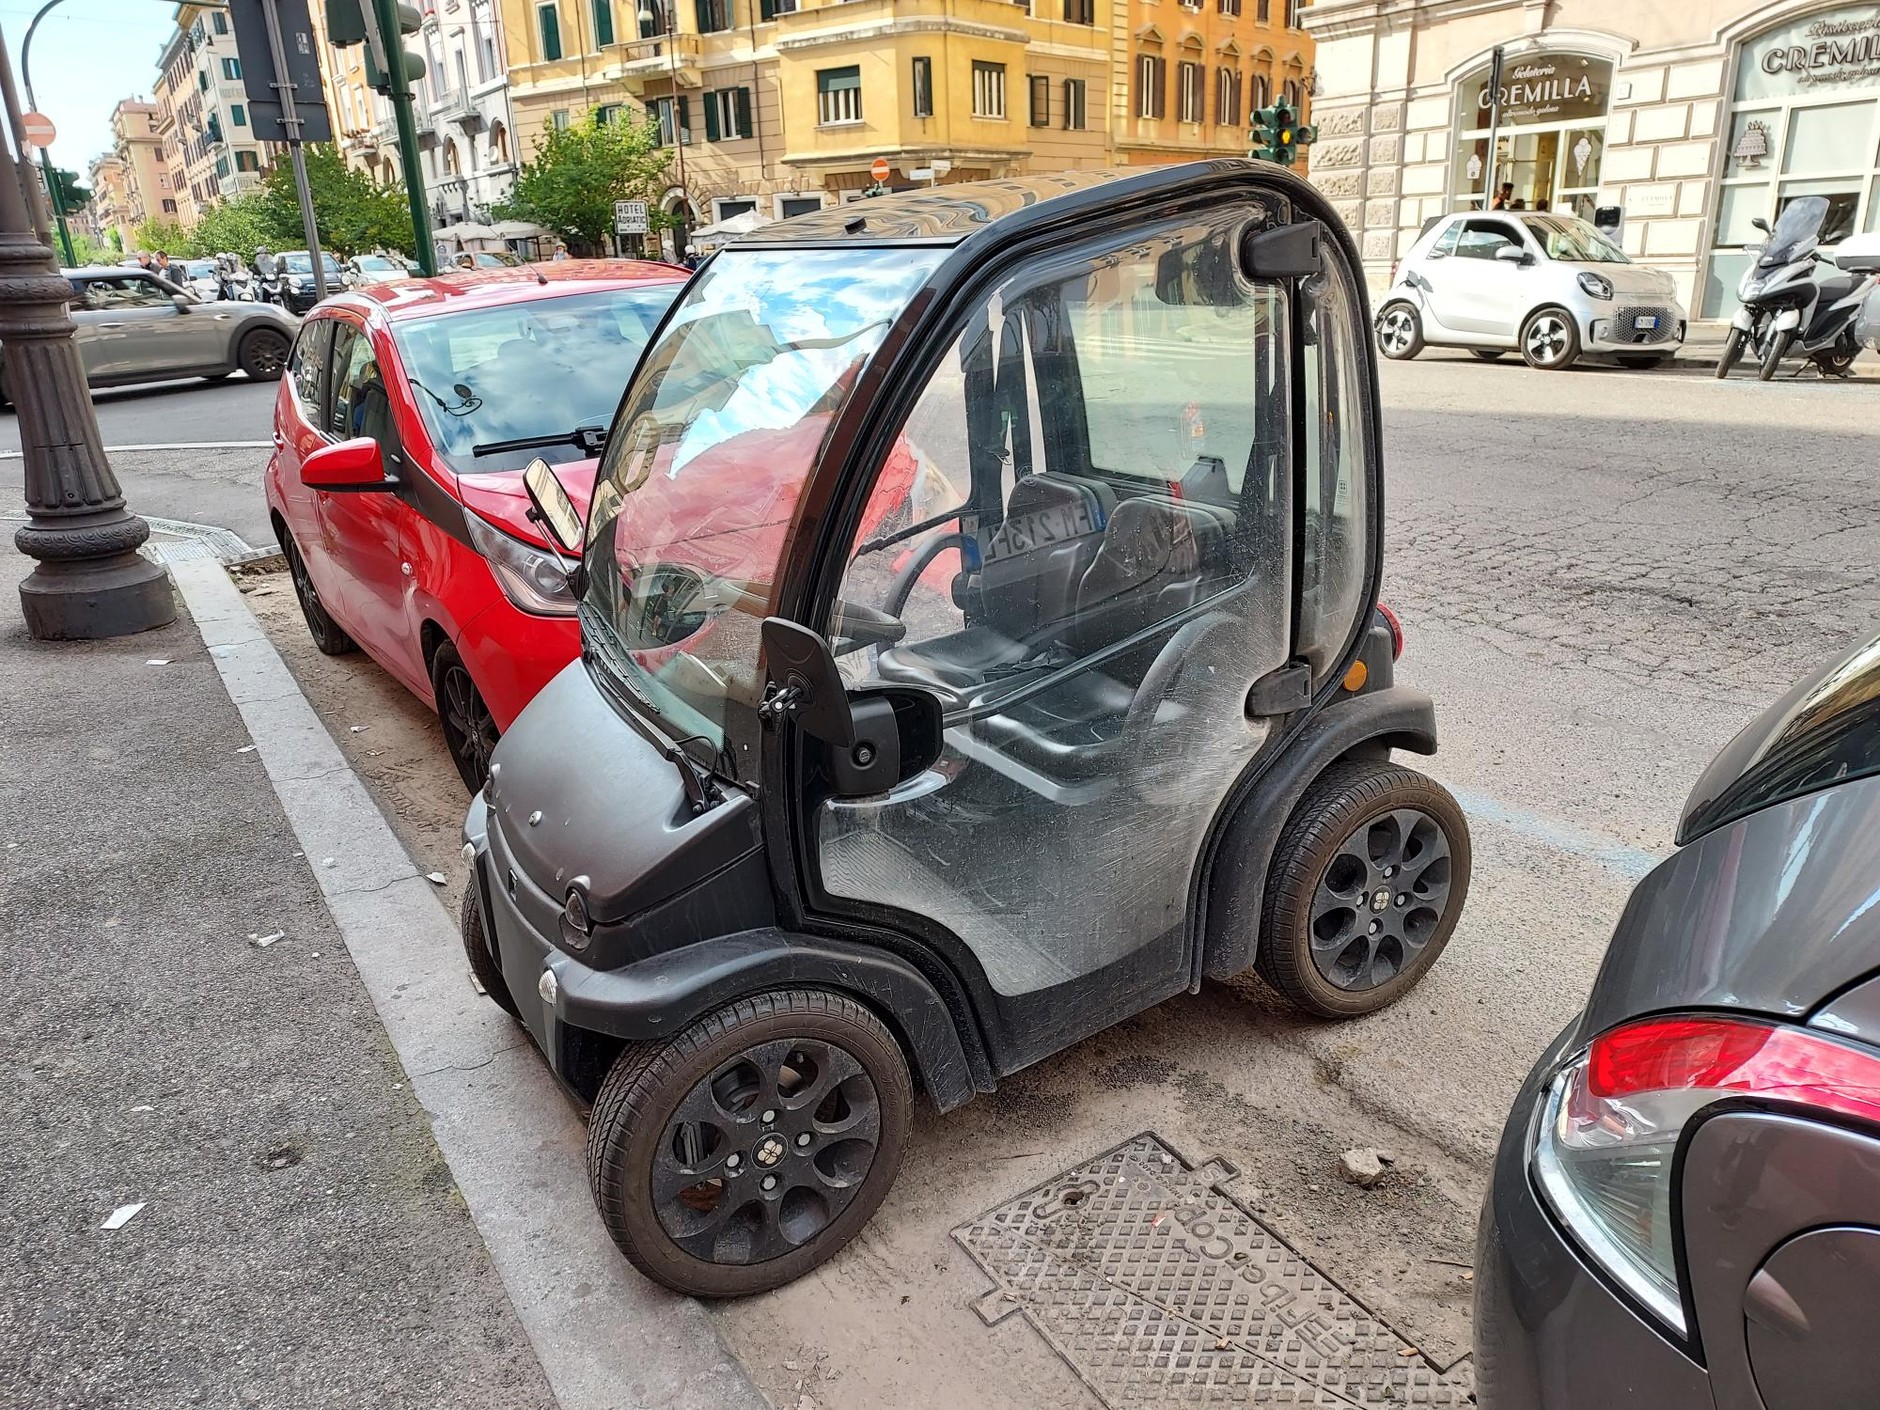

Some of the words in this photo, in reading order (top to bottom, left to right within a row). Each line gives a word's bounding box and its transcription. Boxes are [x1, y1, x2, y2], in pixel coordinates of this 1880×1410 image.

[1478, 75, 1592, 109] CREMILLA
[617, 204, 644, 214] HOTEL
[1171, 1202, 1316, 1331] FiberCop
